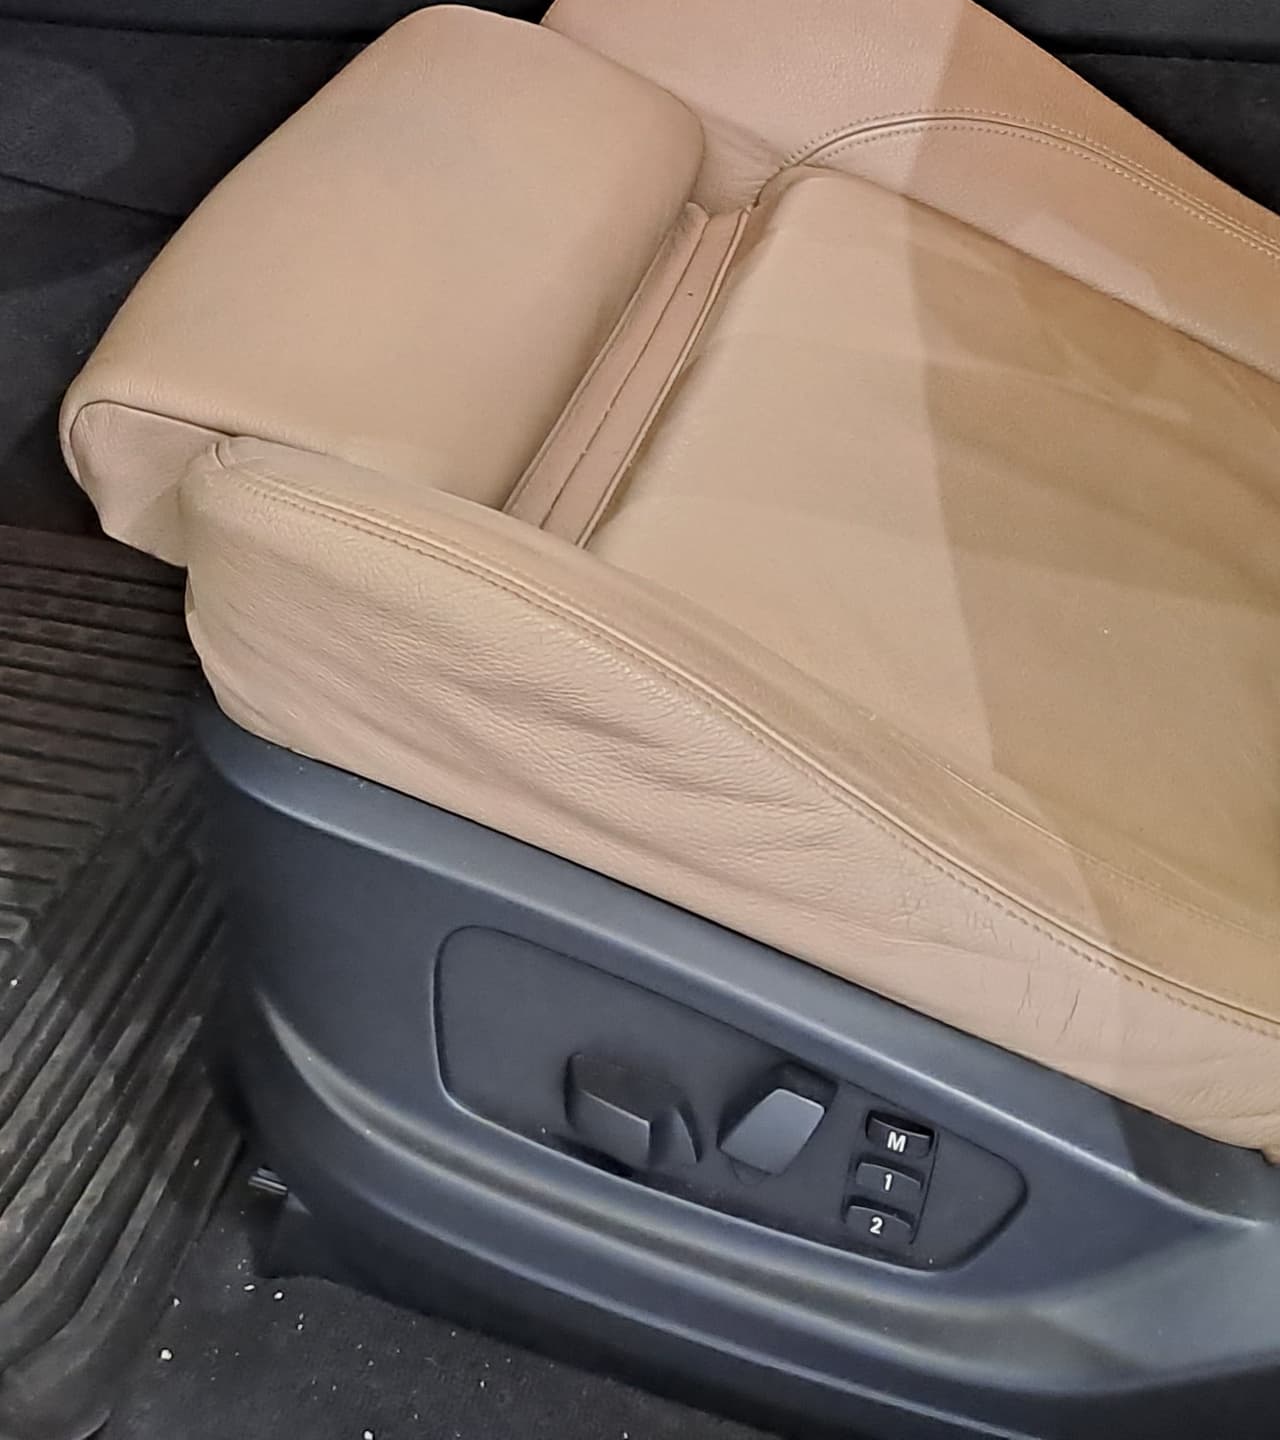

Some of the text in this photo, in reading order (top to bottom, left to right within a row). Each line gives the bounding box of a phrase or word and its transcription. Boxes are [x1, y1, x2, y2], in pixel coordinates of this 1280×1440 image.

[887, 1131, 907, 1153] M
[884, 1173, 893, 1191] 1
[870, 1217, 883, 1235] 2
